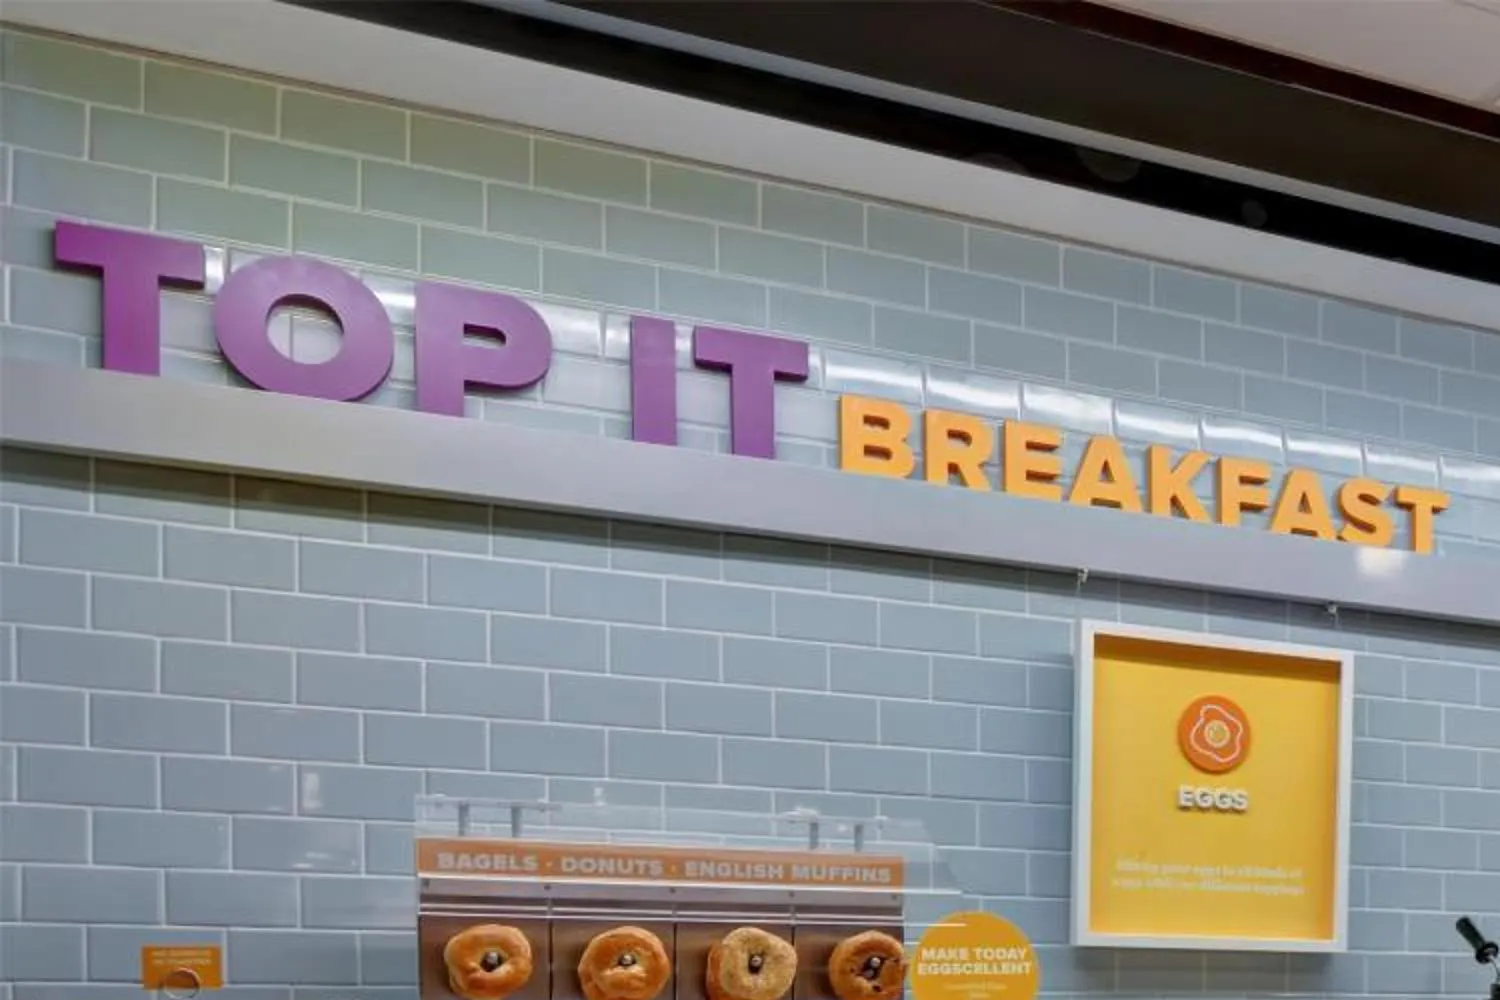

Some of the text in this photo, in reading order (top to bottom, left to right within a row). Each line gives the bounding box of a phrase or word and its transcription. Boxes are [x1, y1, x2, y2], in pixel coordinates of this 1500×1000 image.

[54, 219, 1450, 555] TOP IT BREAKFAST
[1177, 784, 1249, 813] EGGS
[436, 851, 893, 884] BAGELS DONUTS ENGLISH MUFFINS
[917, 961, 1033, 976] EGGSCELLENT
[921, 947, 1027, 961] MAKE TODAY
